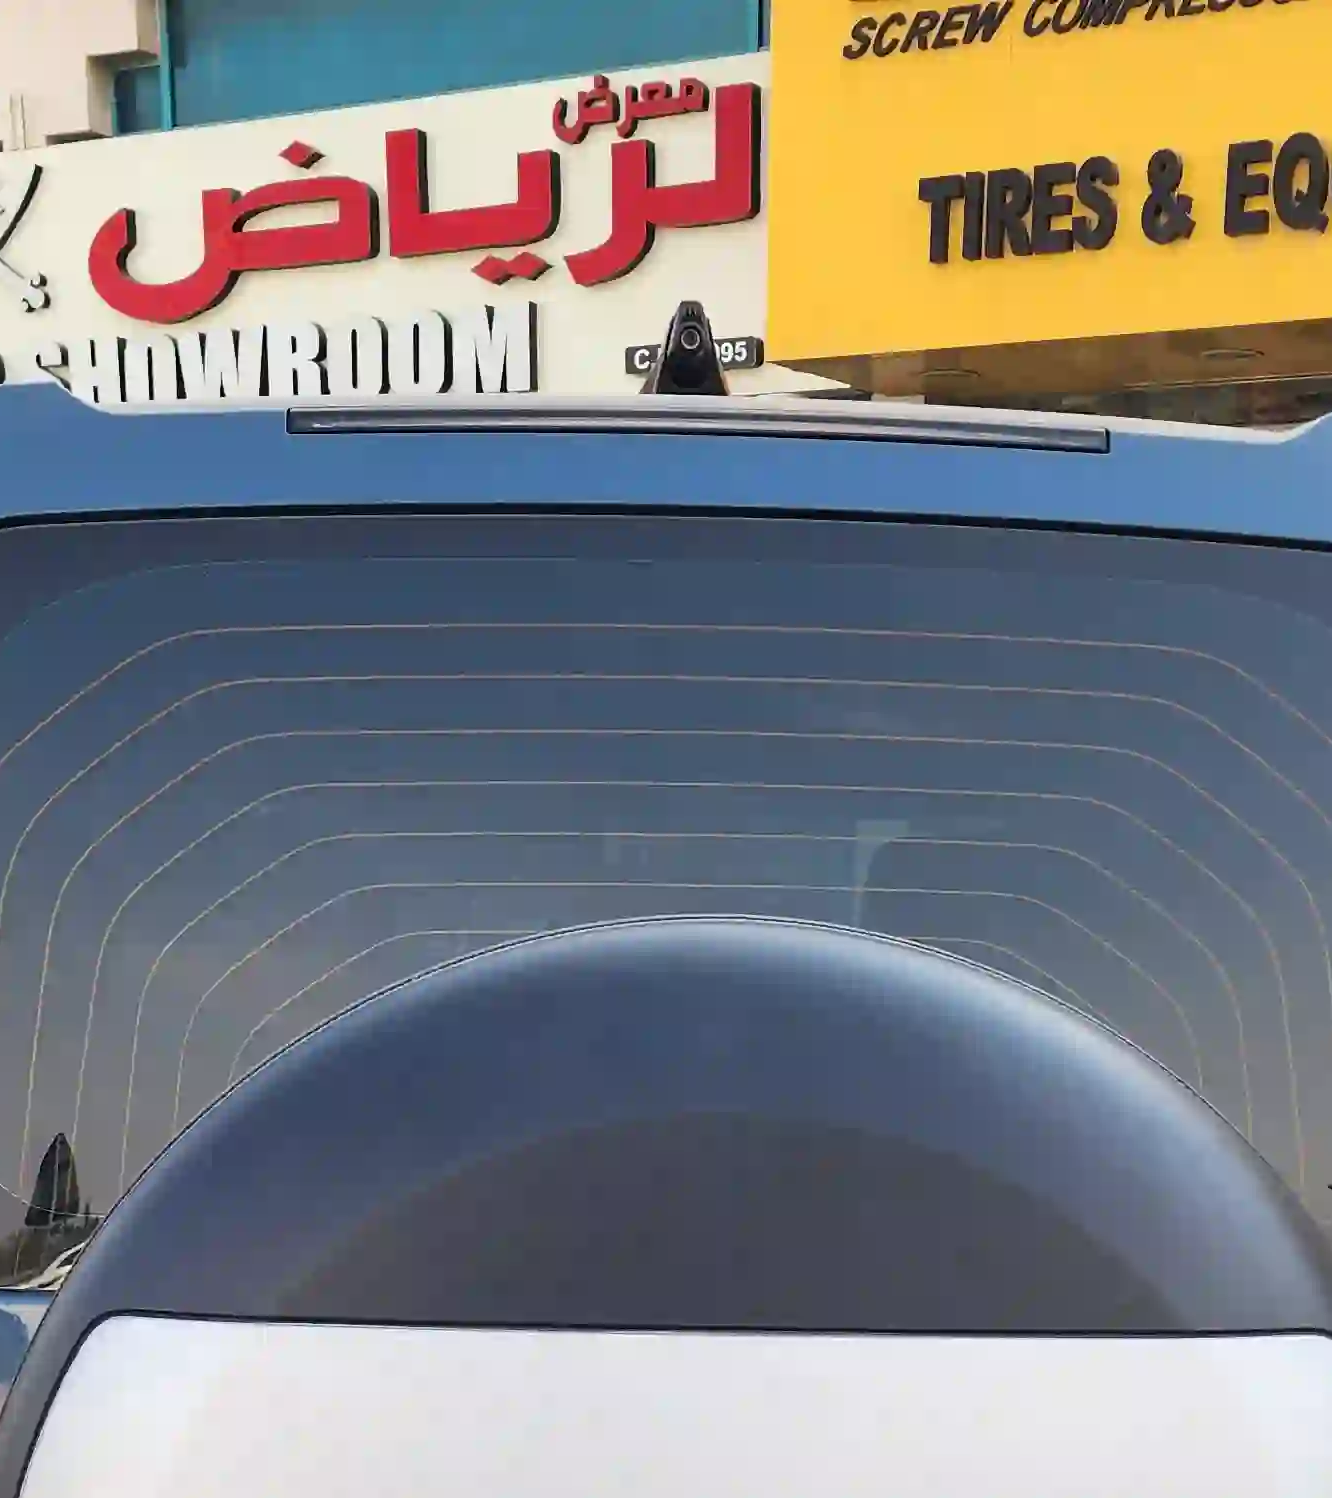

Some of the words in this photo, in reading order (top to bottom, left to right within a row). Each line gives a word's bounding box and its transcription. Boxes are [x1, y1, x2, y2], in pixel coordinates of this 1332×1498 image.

[841, 0, 1014, 61] SCREW
[552, 74, 710, 145] معرض
[918, 155, 1121, 266] TIRES
[1140, 147, 1197, 246] &
